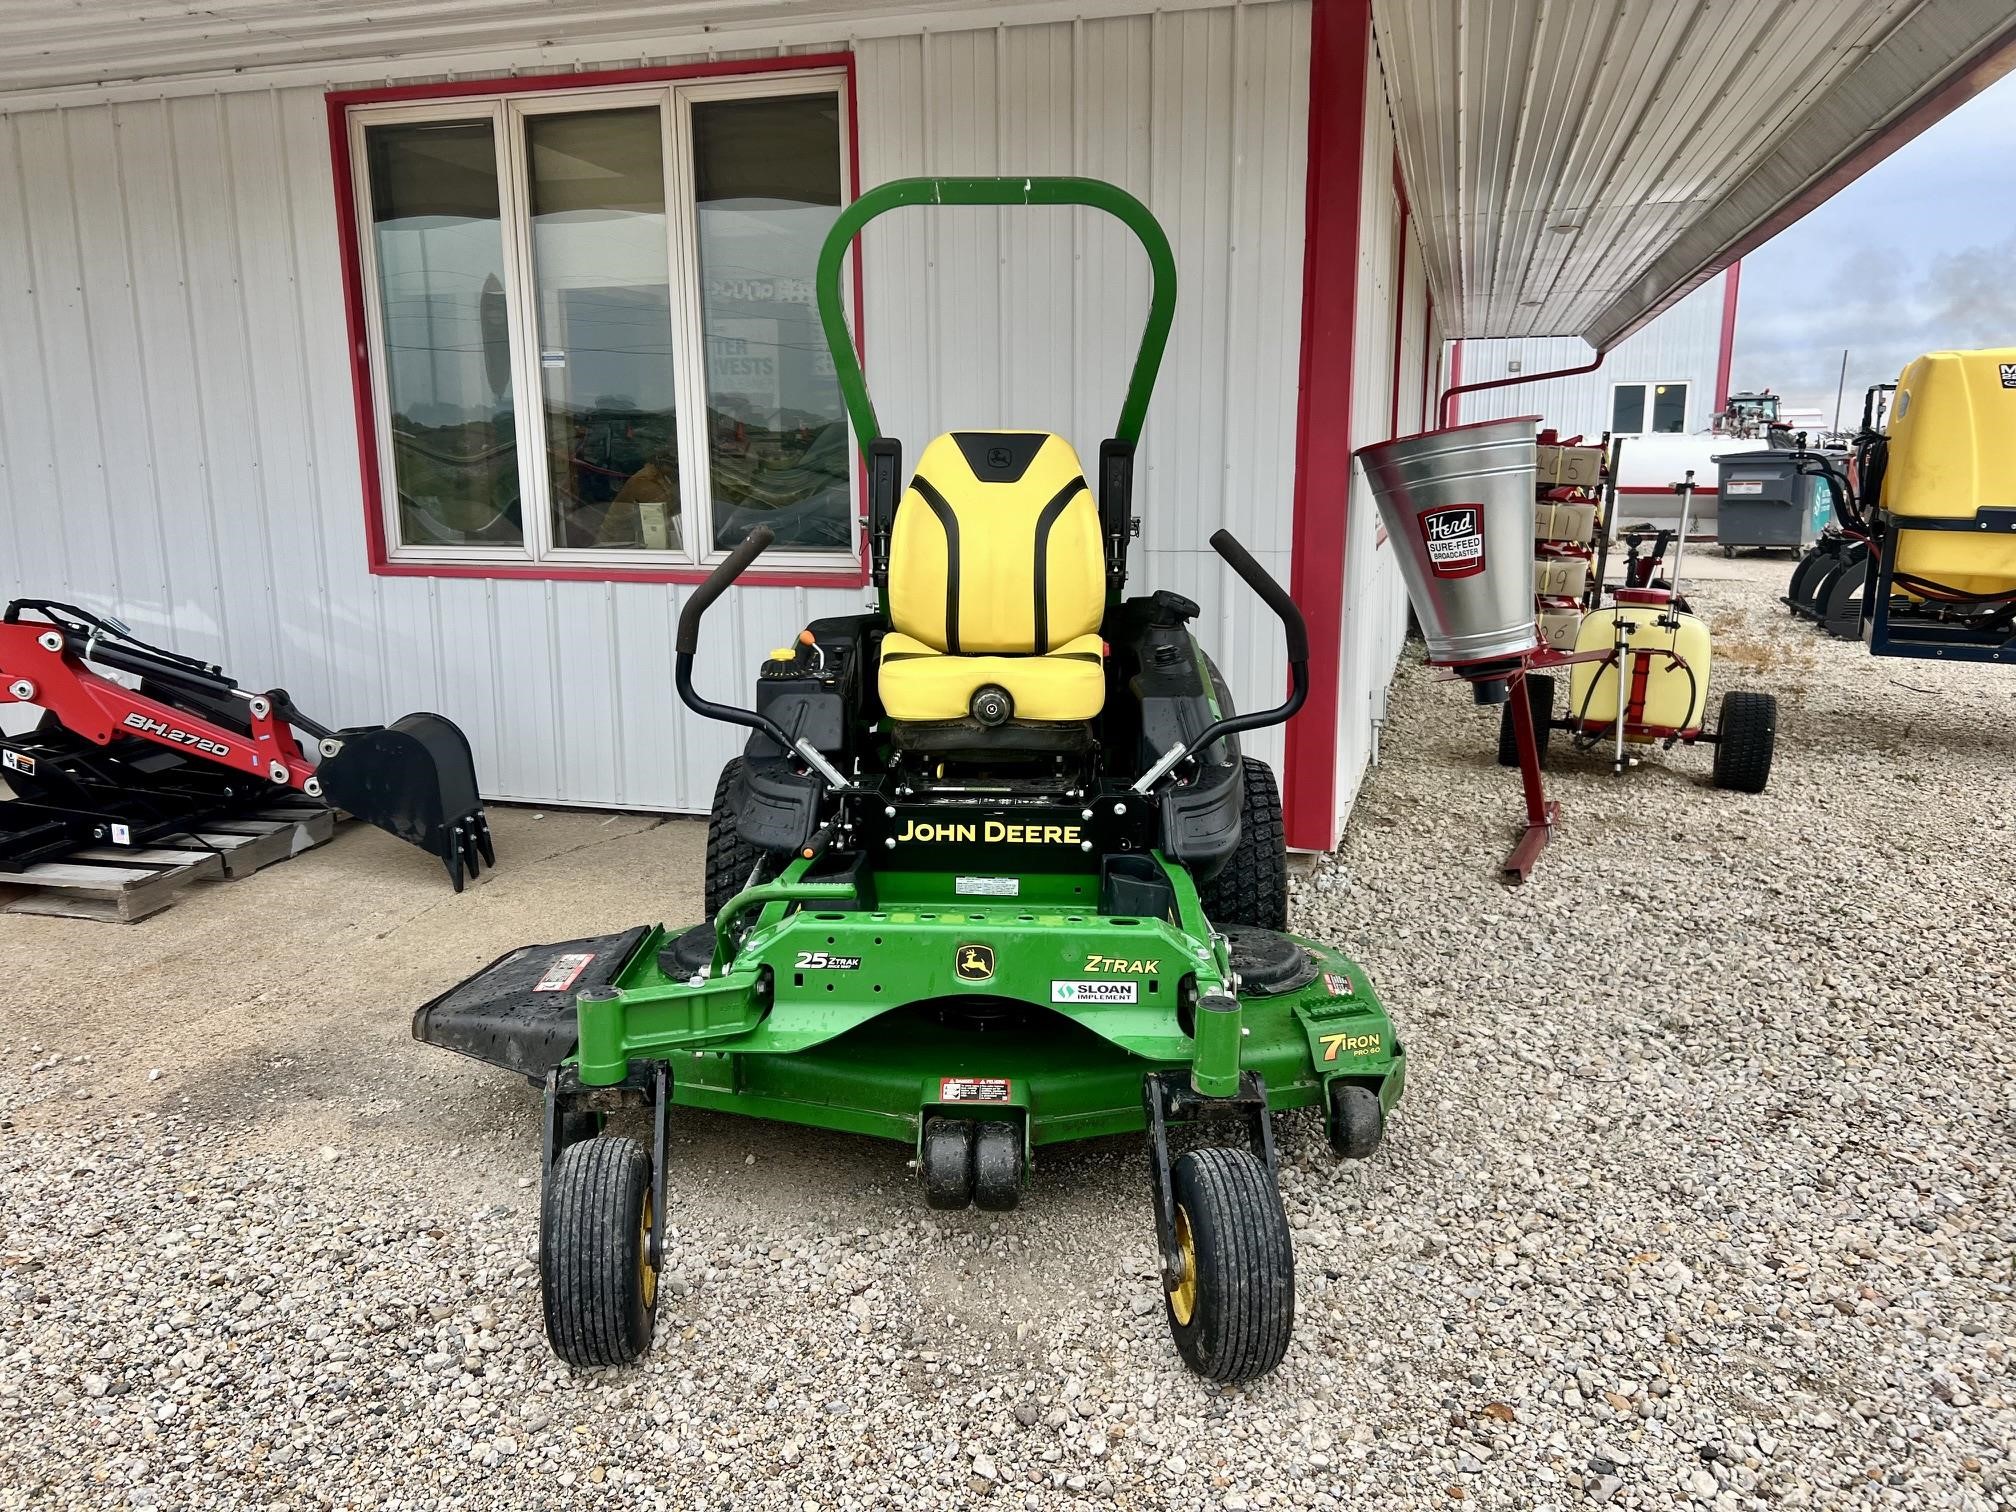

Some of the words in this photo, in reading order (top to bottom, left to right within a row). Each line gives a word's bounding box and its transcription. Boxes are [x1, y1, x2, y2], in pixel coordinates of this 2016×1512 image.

[1428, 512, 1473, 540] Herd
[1429, 537, 1480, 552] SURE-FEED
[1433, 548, 1479, 560] BROADCASTER
[123, 712, 231, 757] BH.2720
[897, 820, 976, 843] JOHN
[984, 821, 1081, 844] DEERE
[794, 952, 829, 969] 25
[828, 957, 859, 966] ZTRAK
[1082, 955, 1161, 975] ZTRAK
[1077, 984, 1132, 995] SLOAN
[1353, 1049, 1368, 1057] PRO
